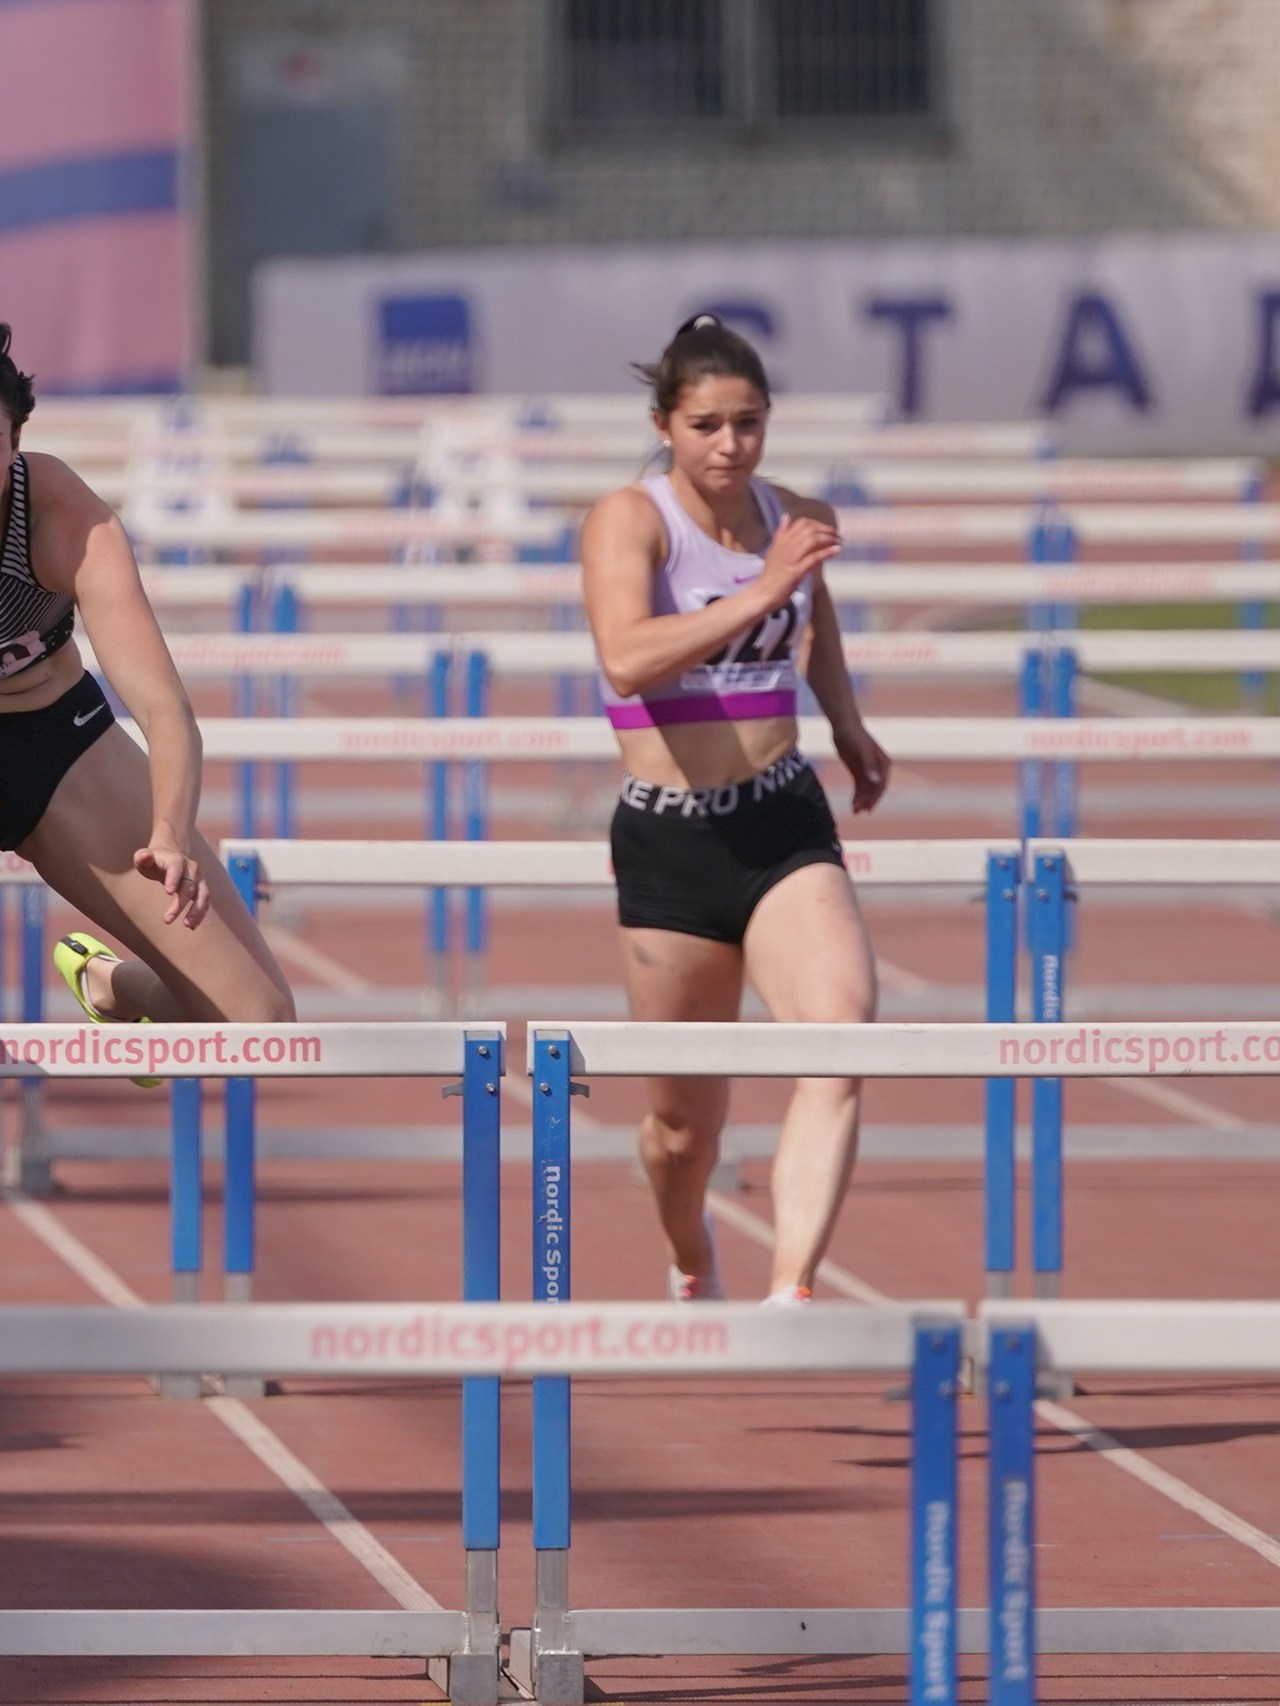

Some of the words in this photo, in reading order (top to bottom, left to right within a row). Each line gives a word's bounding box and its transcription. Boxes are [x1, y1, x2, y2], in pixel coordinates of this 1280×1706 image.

[703, 594, 796, 665] 22
[653, 784, 739, 817] PRO
[998, 1028, 1280, 1073] nordicsport.co
[545, 1164, 563, 1245] nordic
[542, 1249, 562, 1303] Spo
[310, 1312, 730, 1370] nordicsport.com
